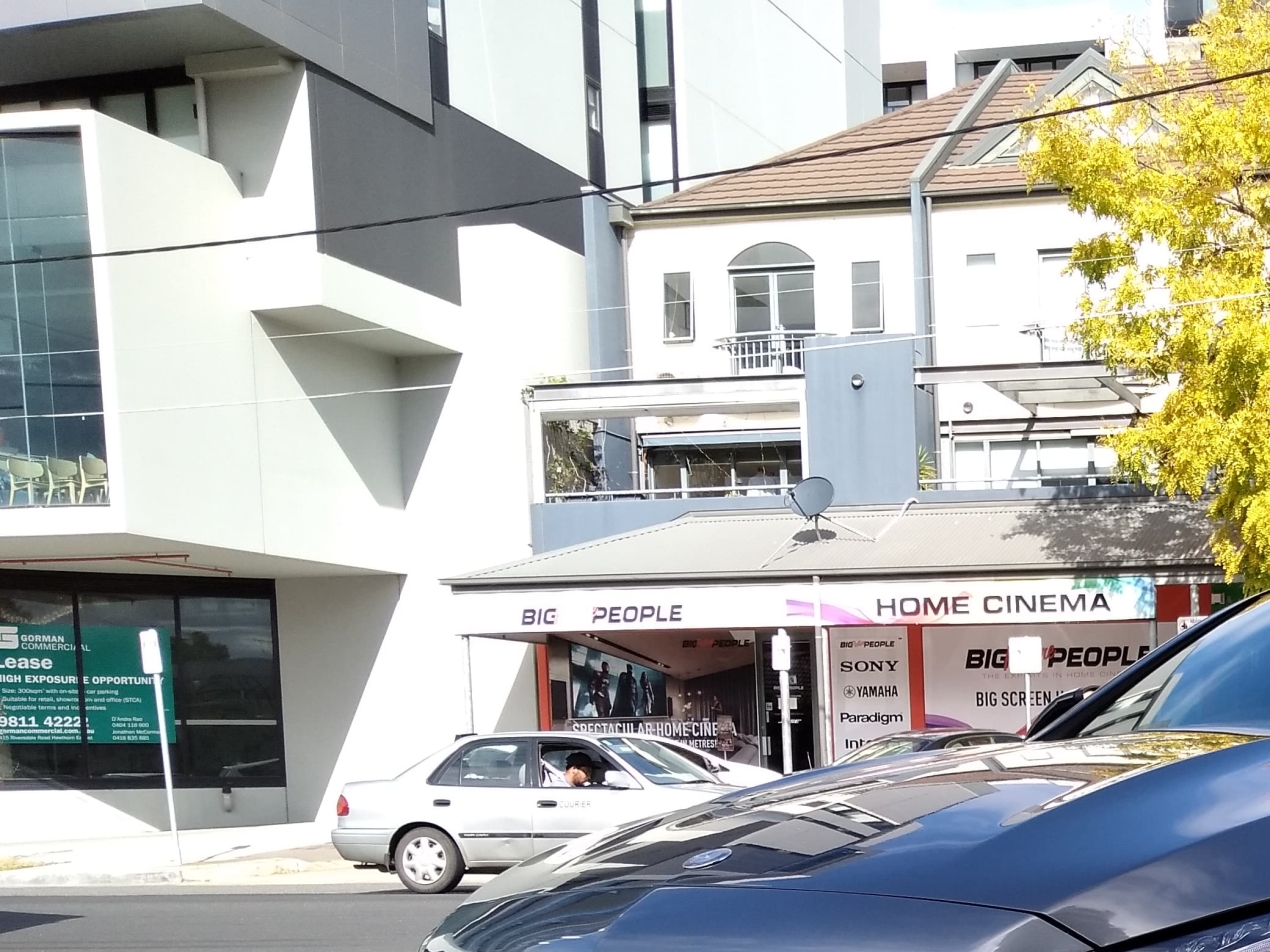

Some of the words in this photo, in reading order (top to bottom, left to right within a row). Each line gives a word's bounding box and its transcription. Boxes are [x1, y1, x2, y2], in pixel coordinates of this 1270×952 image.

[876, 595, 970, 617] HOME
[983, 593, 1110, 614] CINEMA
[521, 608, 557, 626] BIG
[592, 604, 682, 624] PEOPLE
[20, 634, 65, 643] GORMAN
[682, 640, 698, 648] BIG
[712, 639, 750, 648] PEOPLE
[864, 640, 895, 648] PEOPLE
[21, 642, 91, 652] COMMERCIAL
[965, 649, 1008, 669] BIG
[840, 660, 899, 672] SONY
[25, 675, 89, 685] EXPOSURE
[1053, 671, 1062, 679] IN
[857, 685, 898, 698] YAMAHA
[976, 692, 998, 707] BIG
[1001, 691, 1051, 707] SCREEN
[0, 716, 39, 728] 9811
[840, 712, 903, 725] Paradigm
[692, 721, 738, 737] CINEA
[559, 800, 591, 808] COURIER
